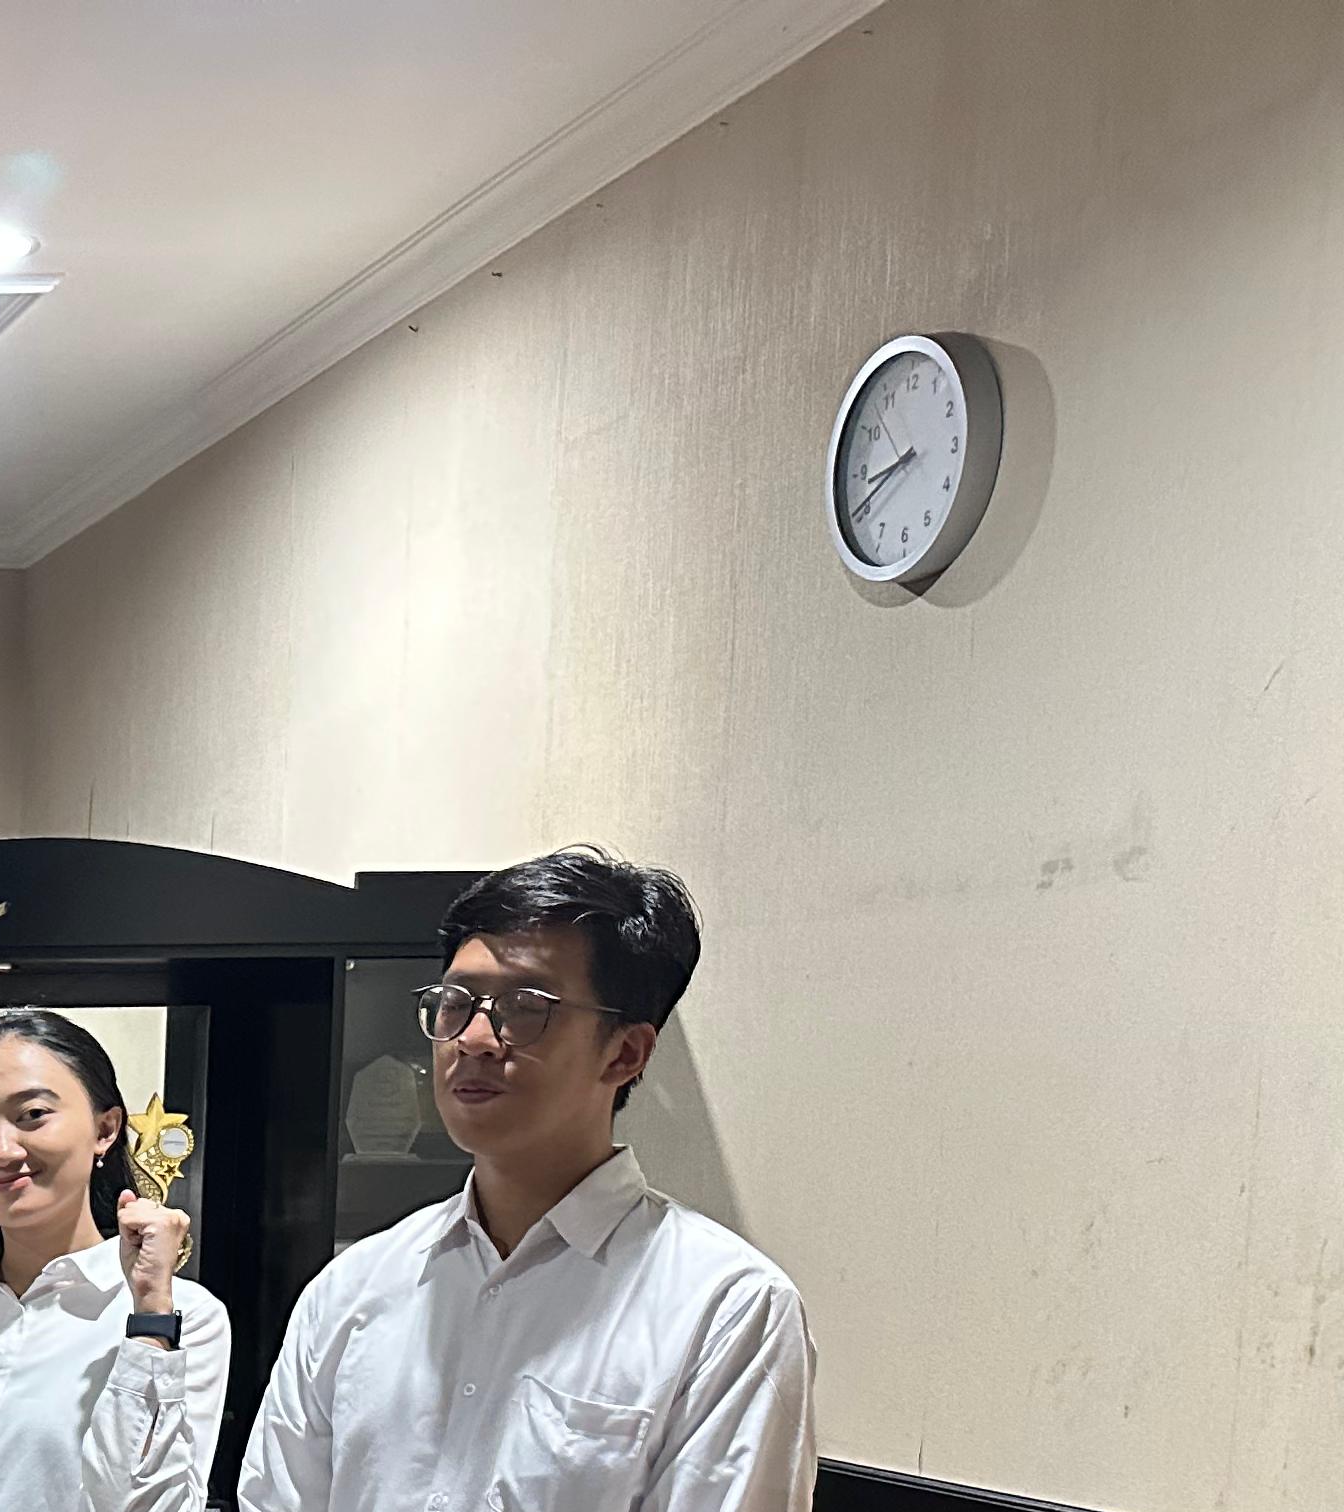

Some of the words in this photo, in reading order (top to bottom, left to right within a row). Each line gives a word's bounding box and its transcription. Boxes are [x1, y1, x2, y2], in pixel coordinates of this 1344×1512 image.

[905, 373, 920, 392] 12
[883, 391, 896, 411] 11
[945, 401, 954, 418] 2
[867, 425, 881, 442] 10
[951, 436, 959, 454] 3
[860, 463, 868, 481] 9
[942, 475, 950, 492] 4
[923, 509, 931, 527] 5
[879, 522, 886, 539] 7
[900, 527, 909, 543] 6
